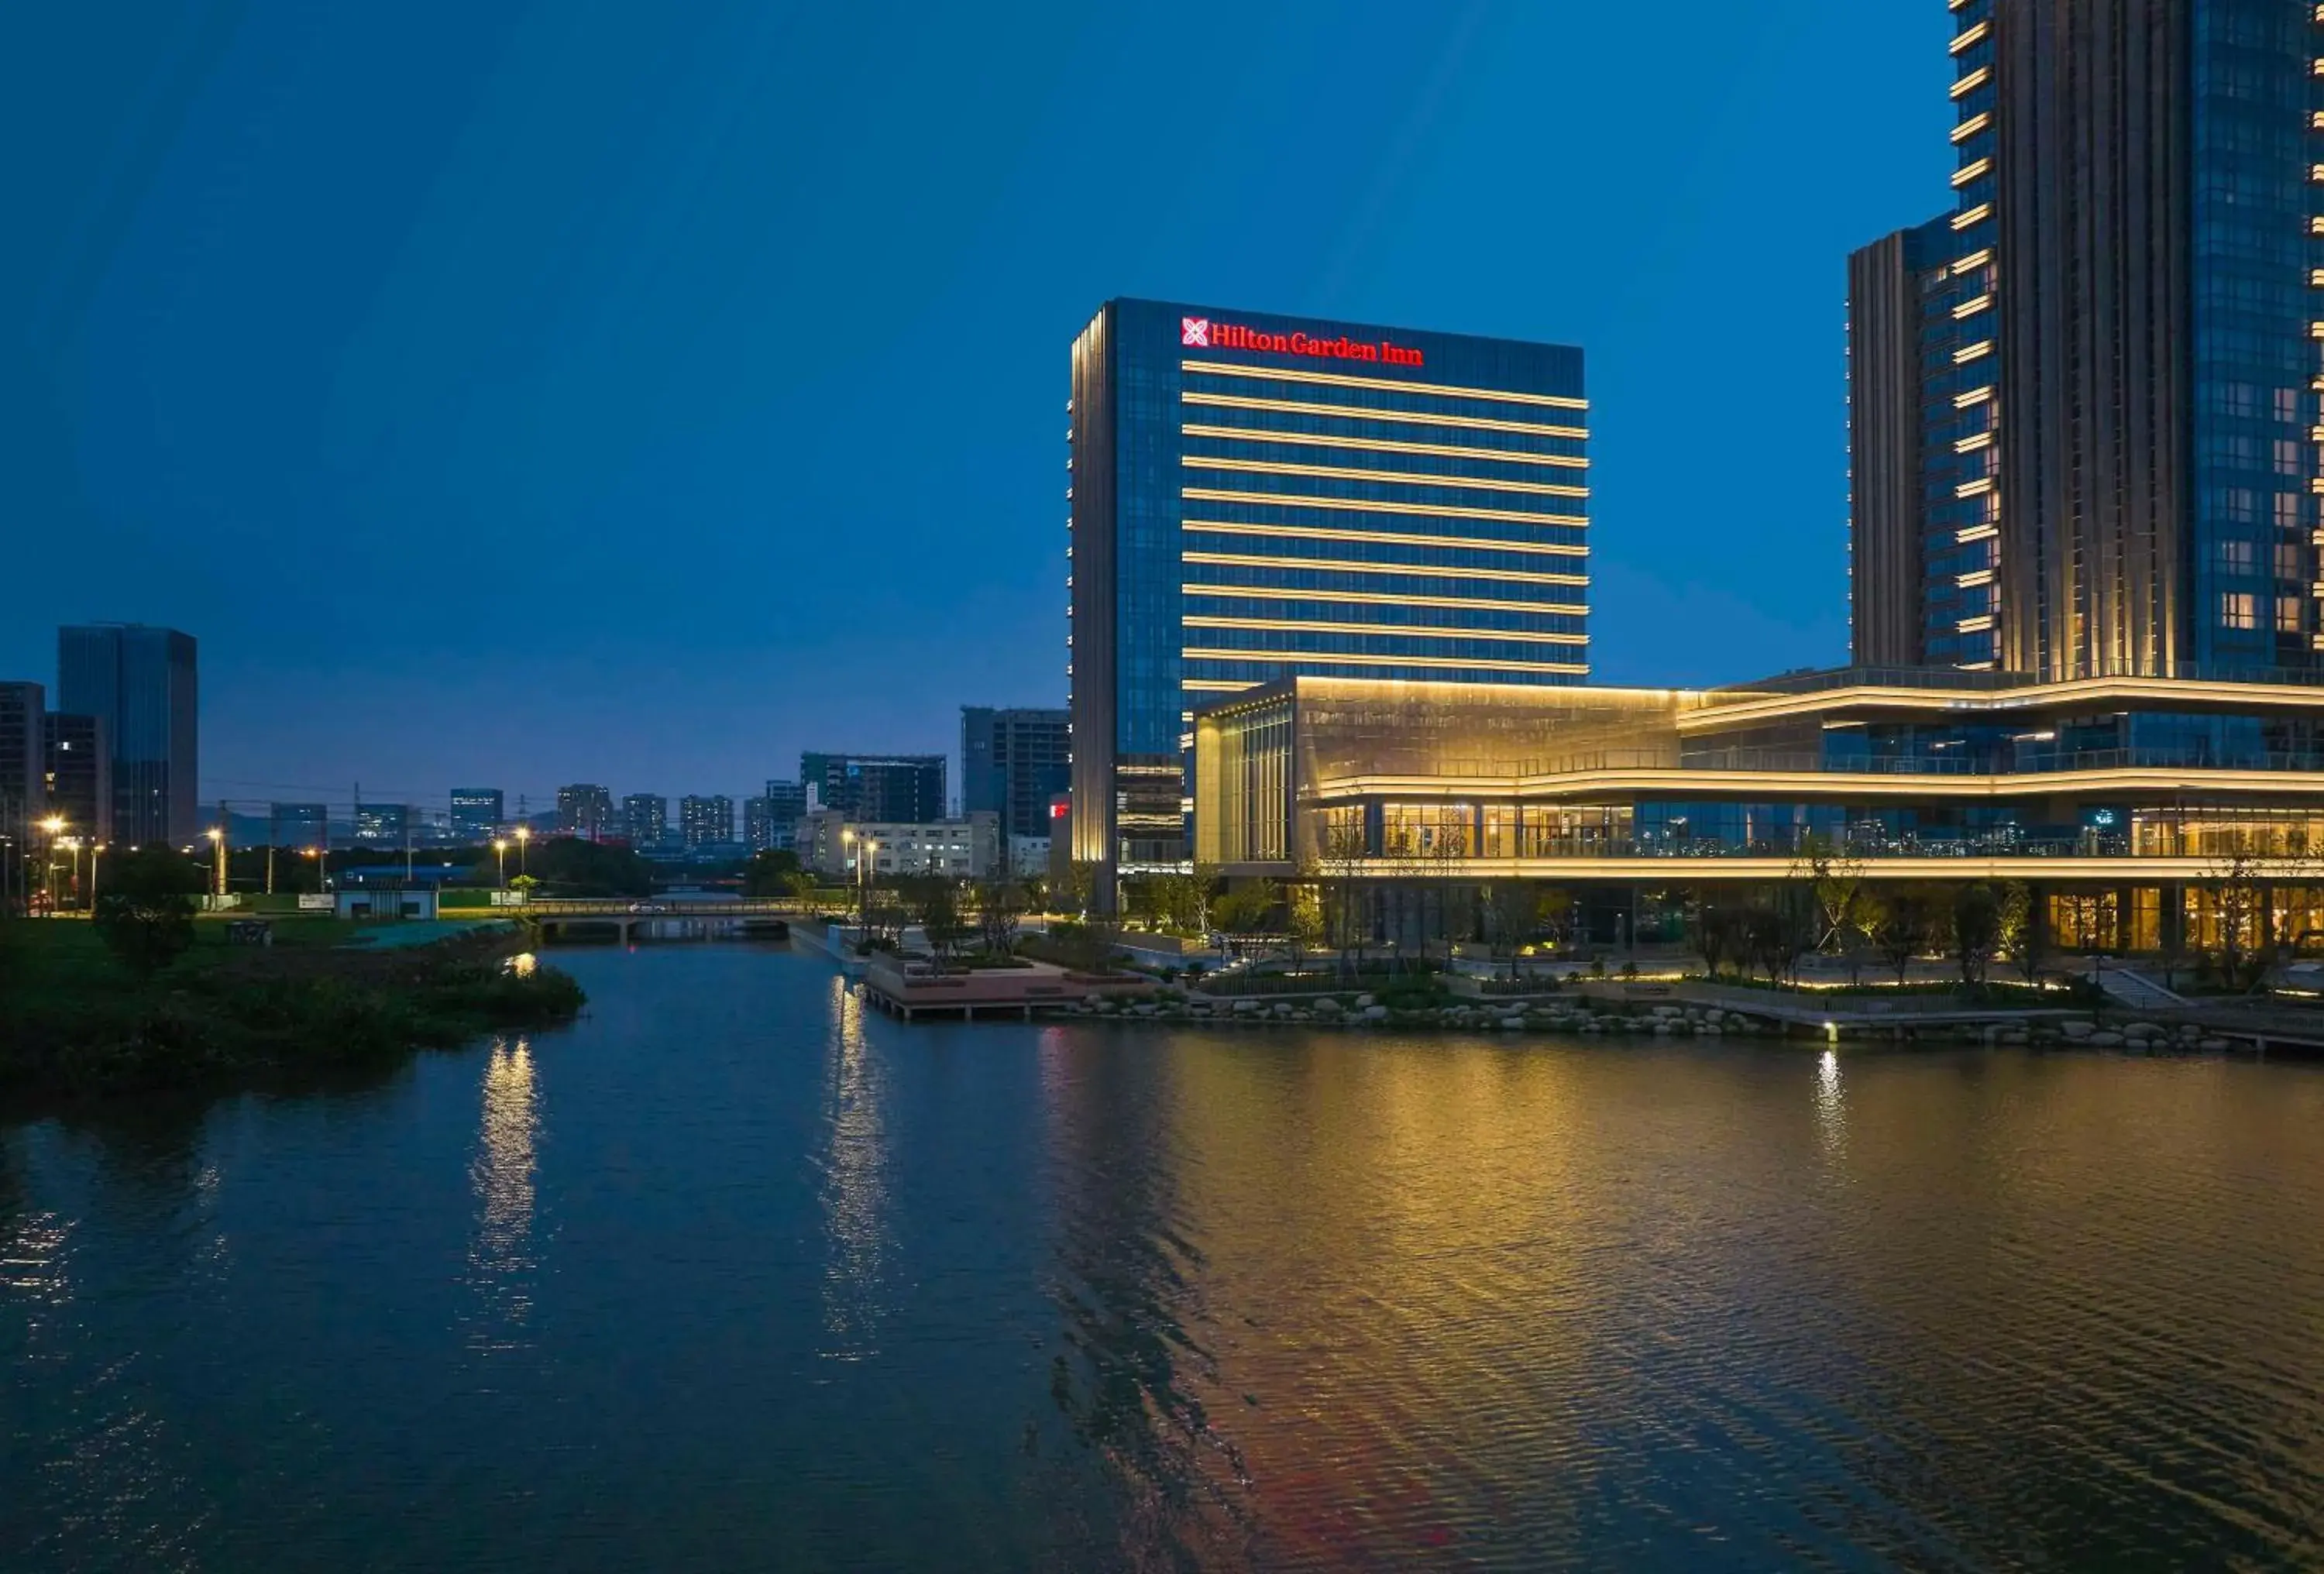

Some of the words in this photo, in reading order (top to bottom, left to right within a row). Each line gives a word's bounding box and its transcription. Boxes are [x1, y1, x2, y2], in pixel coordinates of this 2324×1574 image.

[1212, 322, 1287, 352] Hilton
[1290, 332, 1377, 362] Garden
[1381, 342, 1424, 366] Inn
